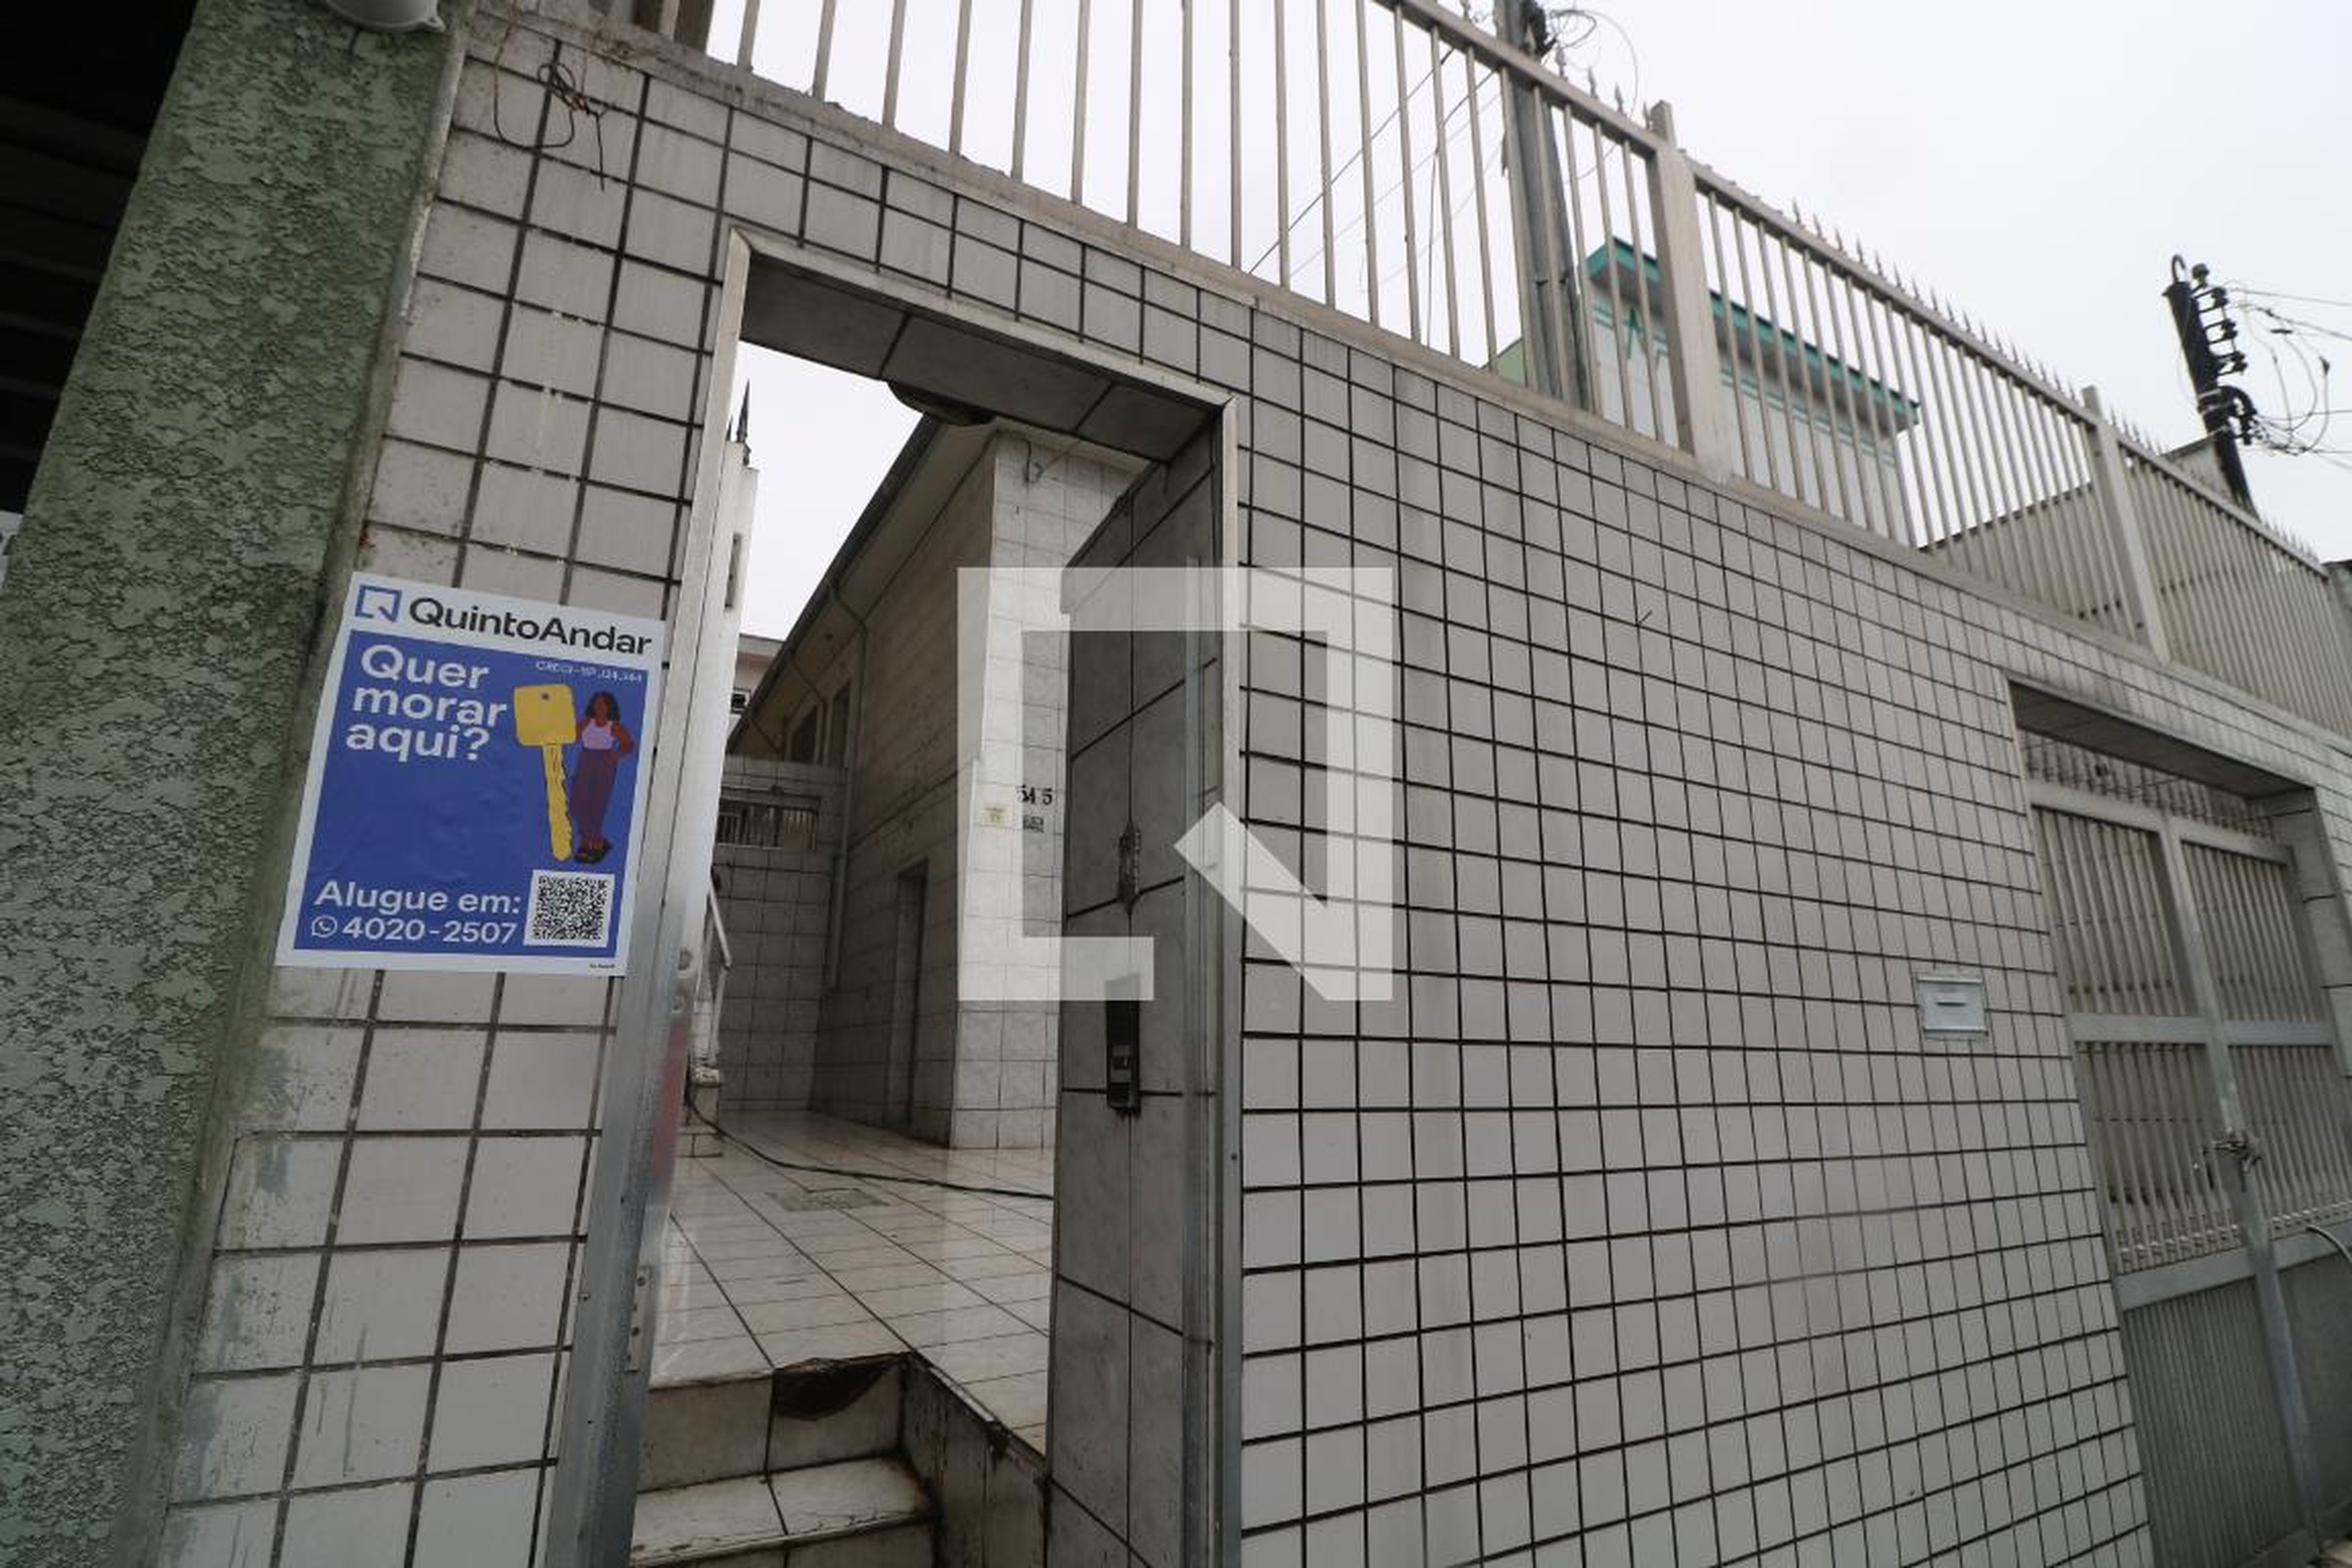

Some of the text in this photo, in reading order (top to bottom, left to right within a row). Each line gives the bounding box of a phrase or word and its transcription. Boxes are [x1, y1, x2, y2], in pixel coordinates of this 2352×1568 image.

[409, 597, 652, 655] QuintoAndar
[361, 644, 489, 688] Quer
[352, 685, 507, 727] morar
[346, 724, 489, 762] aqui?
[314, 880, 521, 915] Alugue em:
